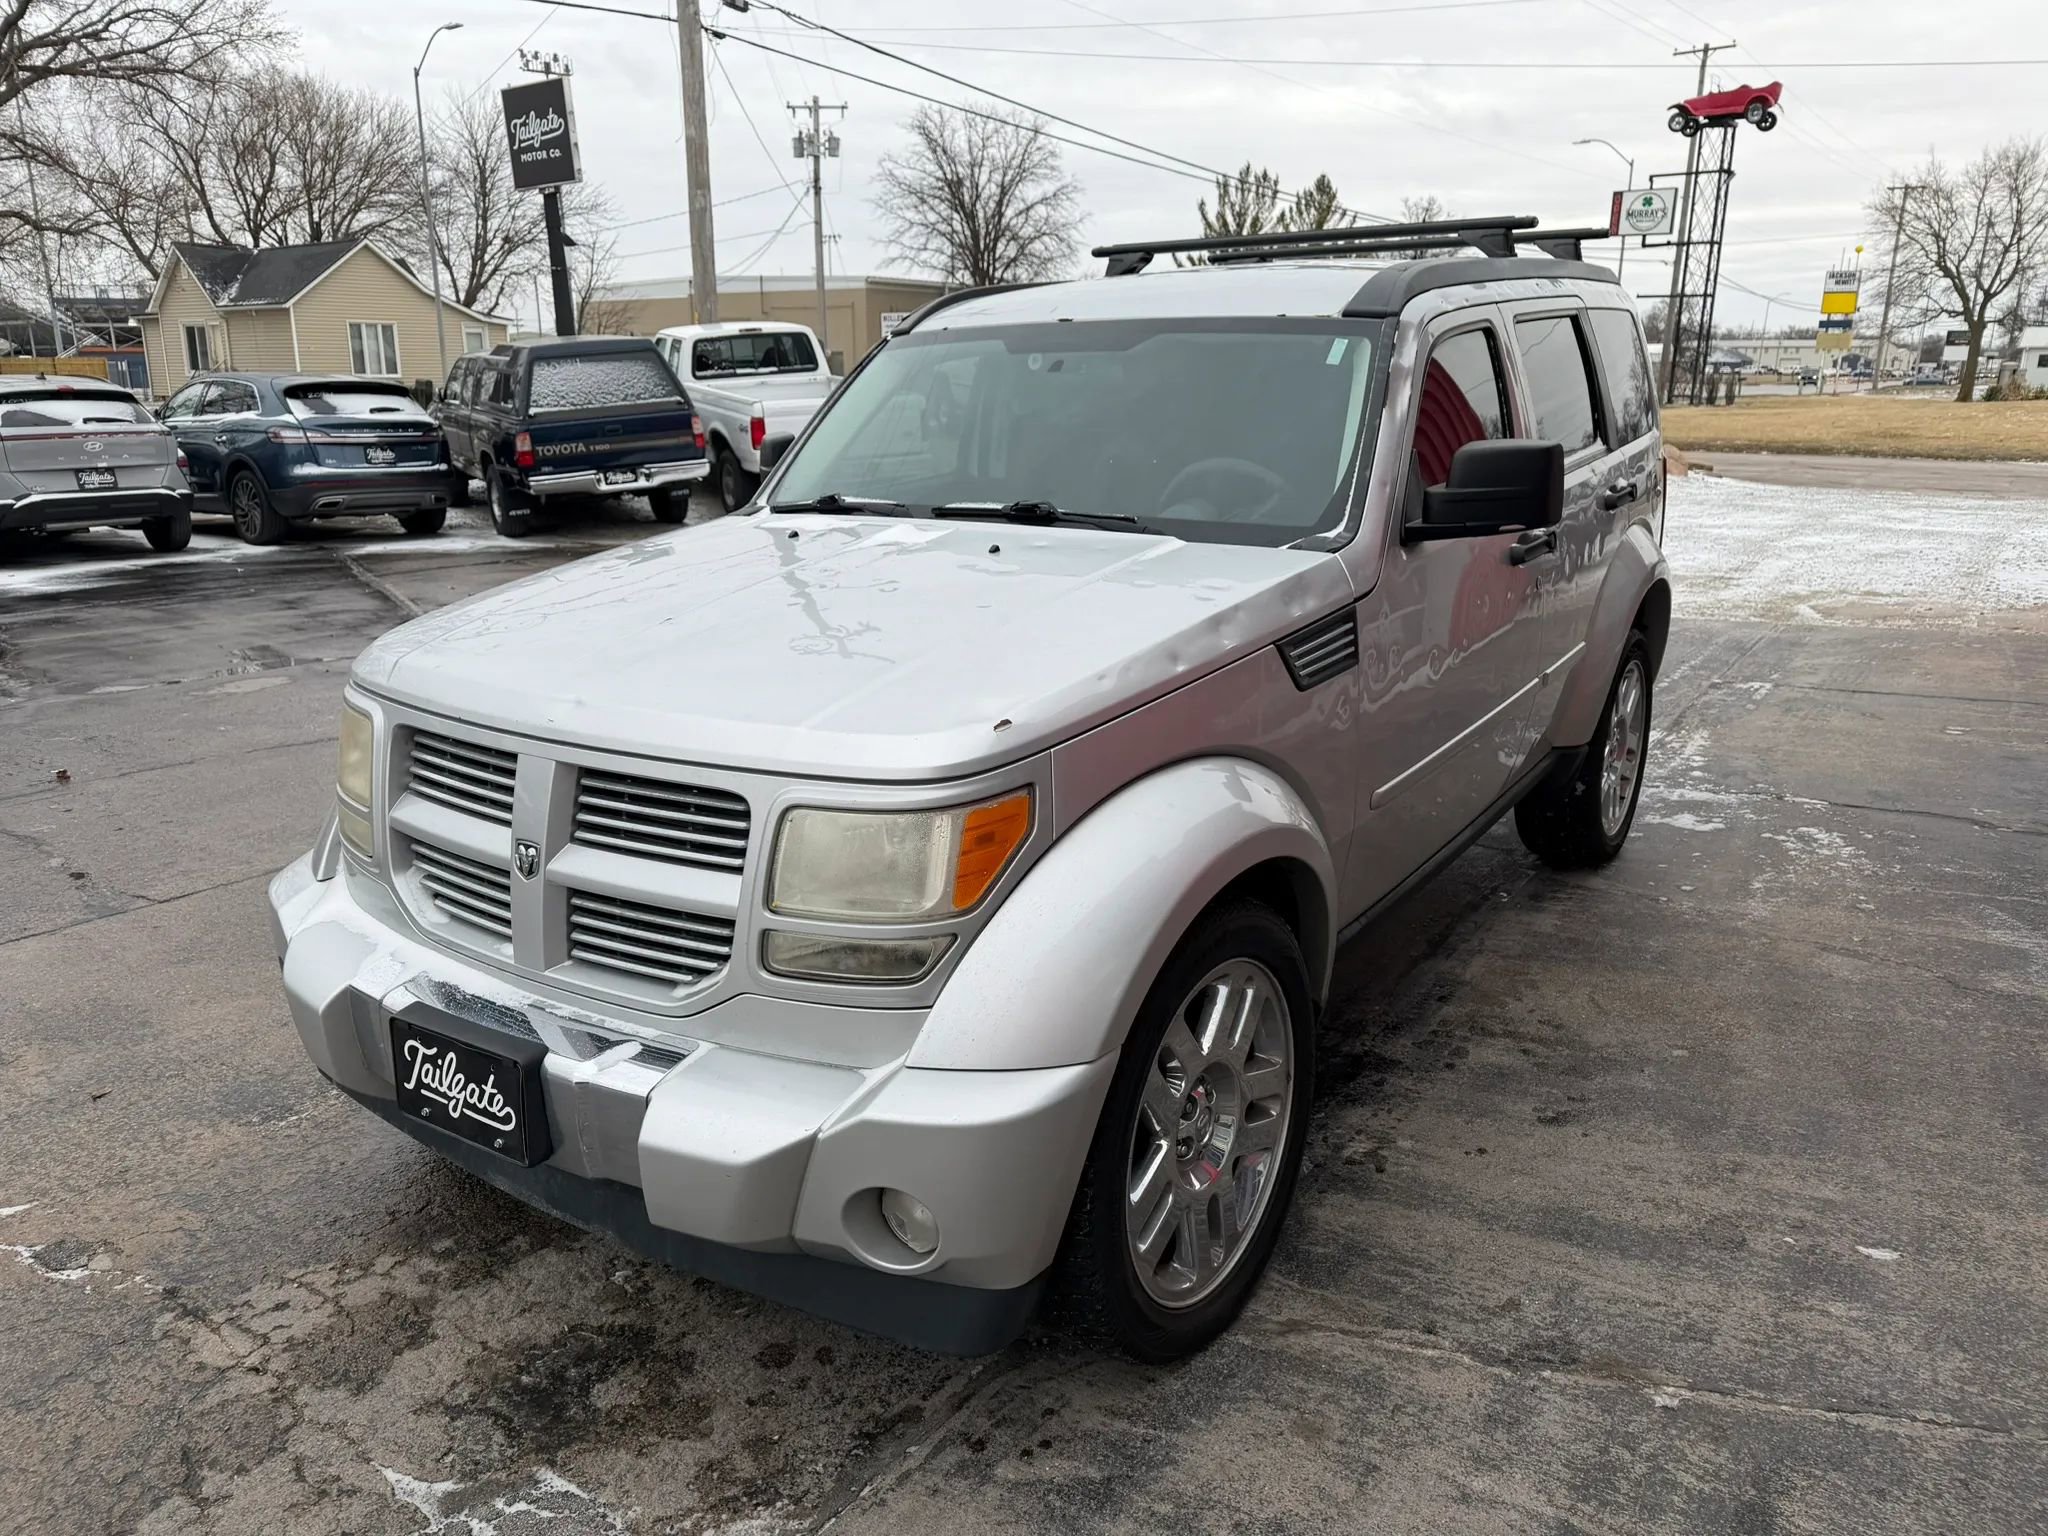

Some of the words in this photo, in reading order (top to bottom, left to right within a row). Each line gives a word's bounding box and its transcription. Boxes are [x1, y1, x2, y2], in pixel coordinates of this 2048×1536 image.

[510, 107, 564, 149] Tailgate
[520, 150, 547, 162] MOTOR
[549, 149, 562, 157] CO.
[536, 443, 586, 456] TOYOTA
[79, 471, 115, 485] Tailgate
[404, 1039, 516, 1131] Tailgate
